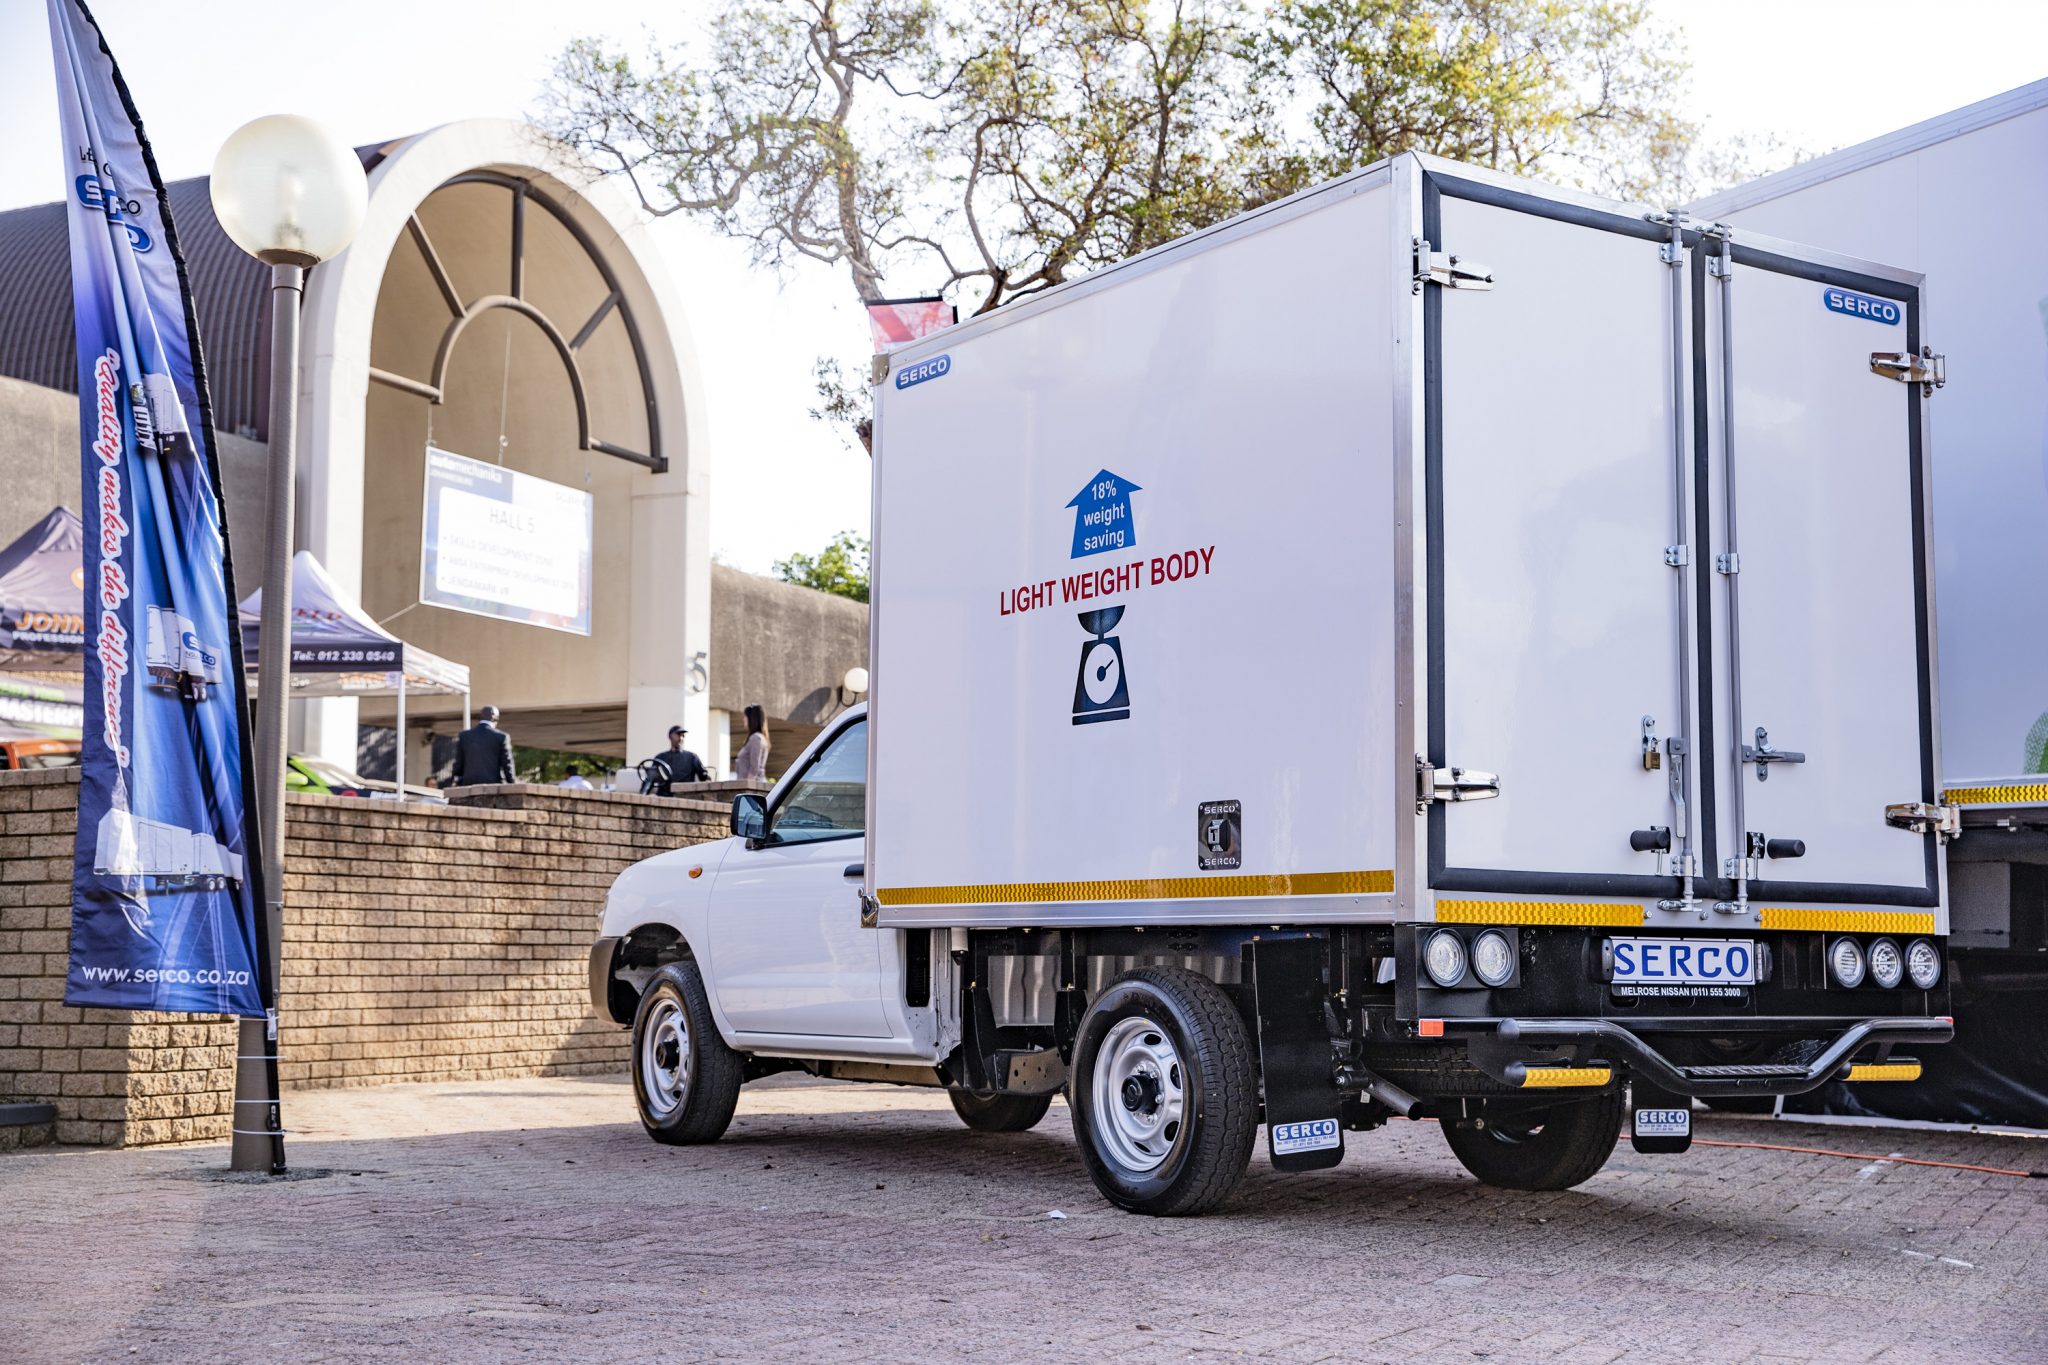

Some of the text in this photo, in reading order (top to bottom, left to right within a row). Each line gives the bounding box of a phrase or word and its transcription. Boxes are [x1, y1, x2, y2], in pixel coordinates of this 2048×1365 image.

[1830, 291, 1896, 321] SERCO
[900, 358, 947, 386] SERCO
[1091, 479, 1117, 500] 18%
[103, 471, 124, 555] makes
[489, 507, 523, 532] HALL
[1083, 502, 1125, 526] weight
[1083, 529, 1125, 550] saving
[103, 563, 125, 605] the
[1000, 545, 1215, 616] LIGHT WEIGHT BODY
[293, 650, 315, 661] Tel:
[317, 650, 340, 661] 012
[342, 650, 364, 661] 330
[1204, 805, 1236, 814] SERCO
[1204, 857, 1236, 866] SERCO
[1614, 943, 1749, 978] SERCO
[82, 966, 250, 985] www.serco.co.za
[1621, 986, 1741, 997] MELROSE NISSAN (011) 555 3000
[1640, 1111, 1685, 1123] SERCO
[1278, 1121, 1333, 1140] SERCO
